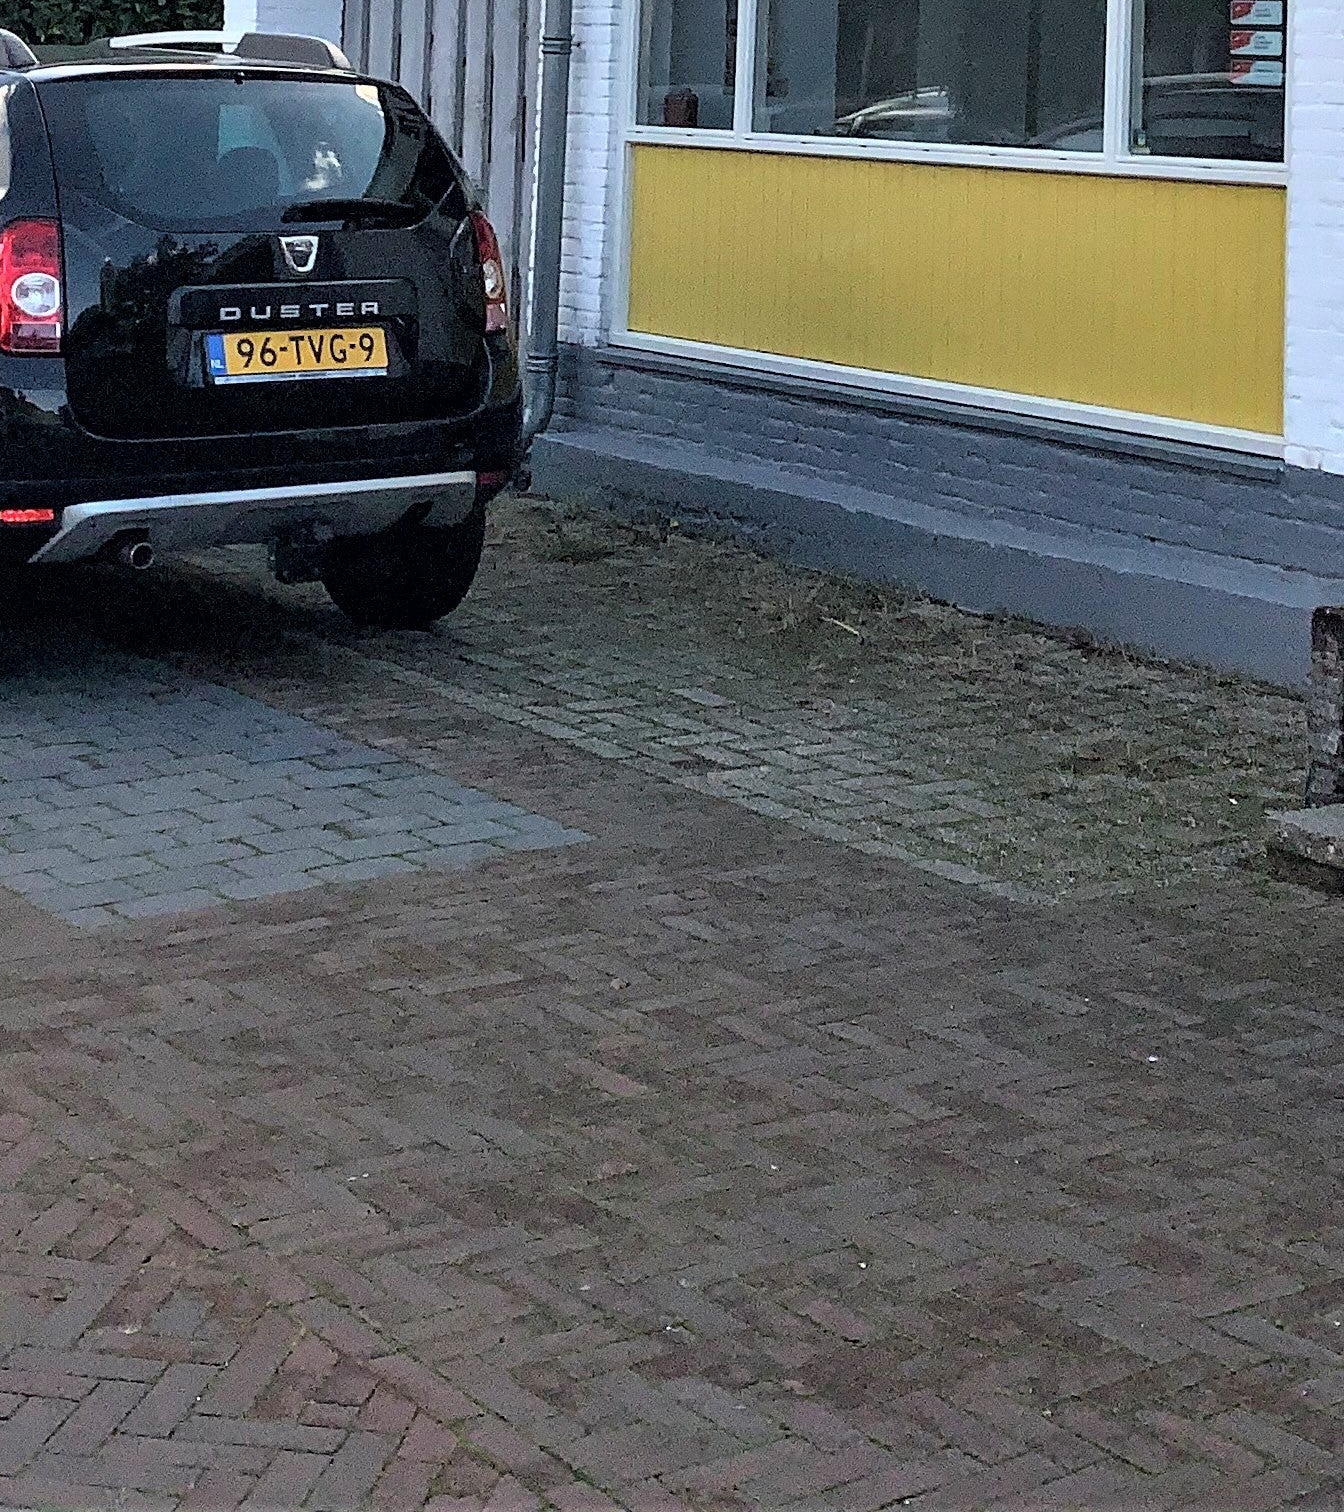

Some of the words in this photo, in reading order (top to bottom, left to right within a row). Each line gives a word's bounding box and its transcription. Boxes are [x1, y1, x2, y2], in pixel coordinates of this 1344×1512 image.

[219, 301, 380, 321] DUSTER
[236, 332, 375, 368] 96-TVG-9
[210, 359, 225, 369] NL
